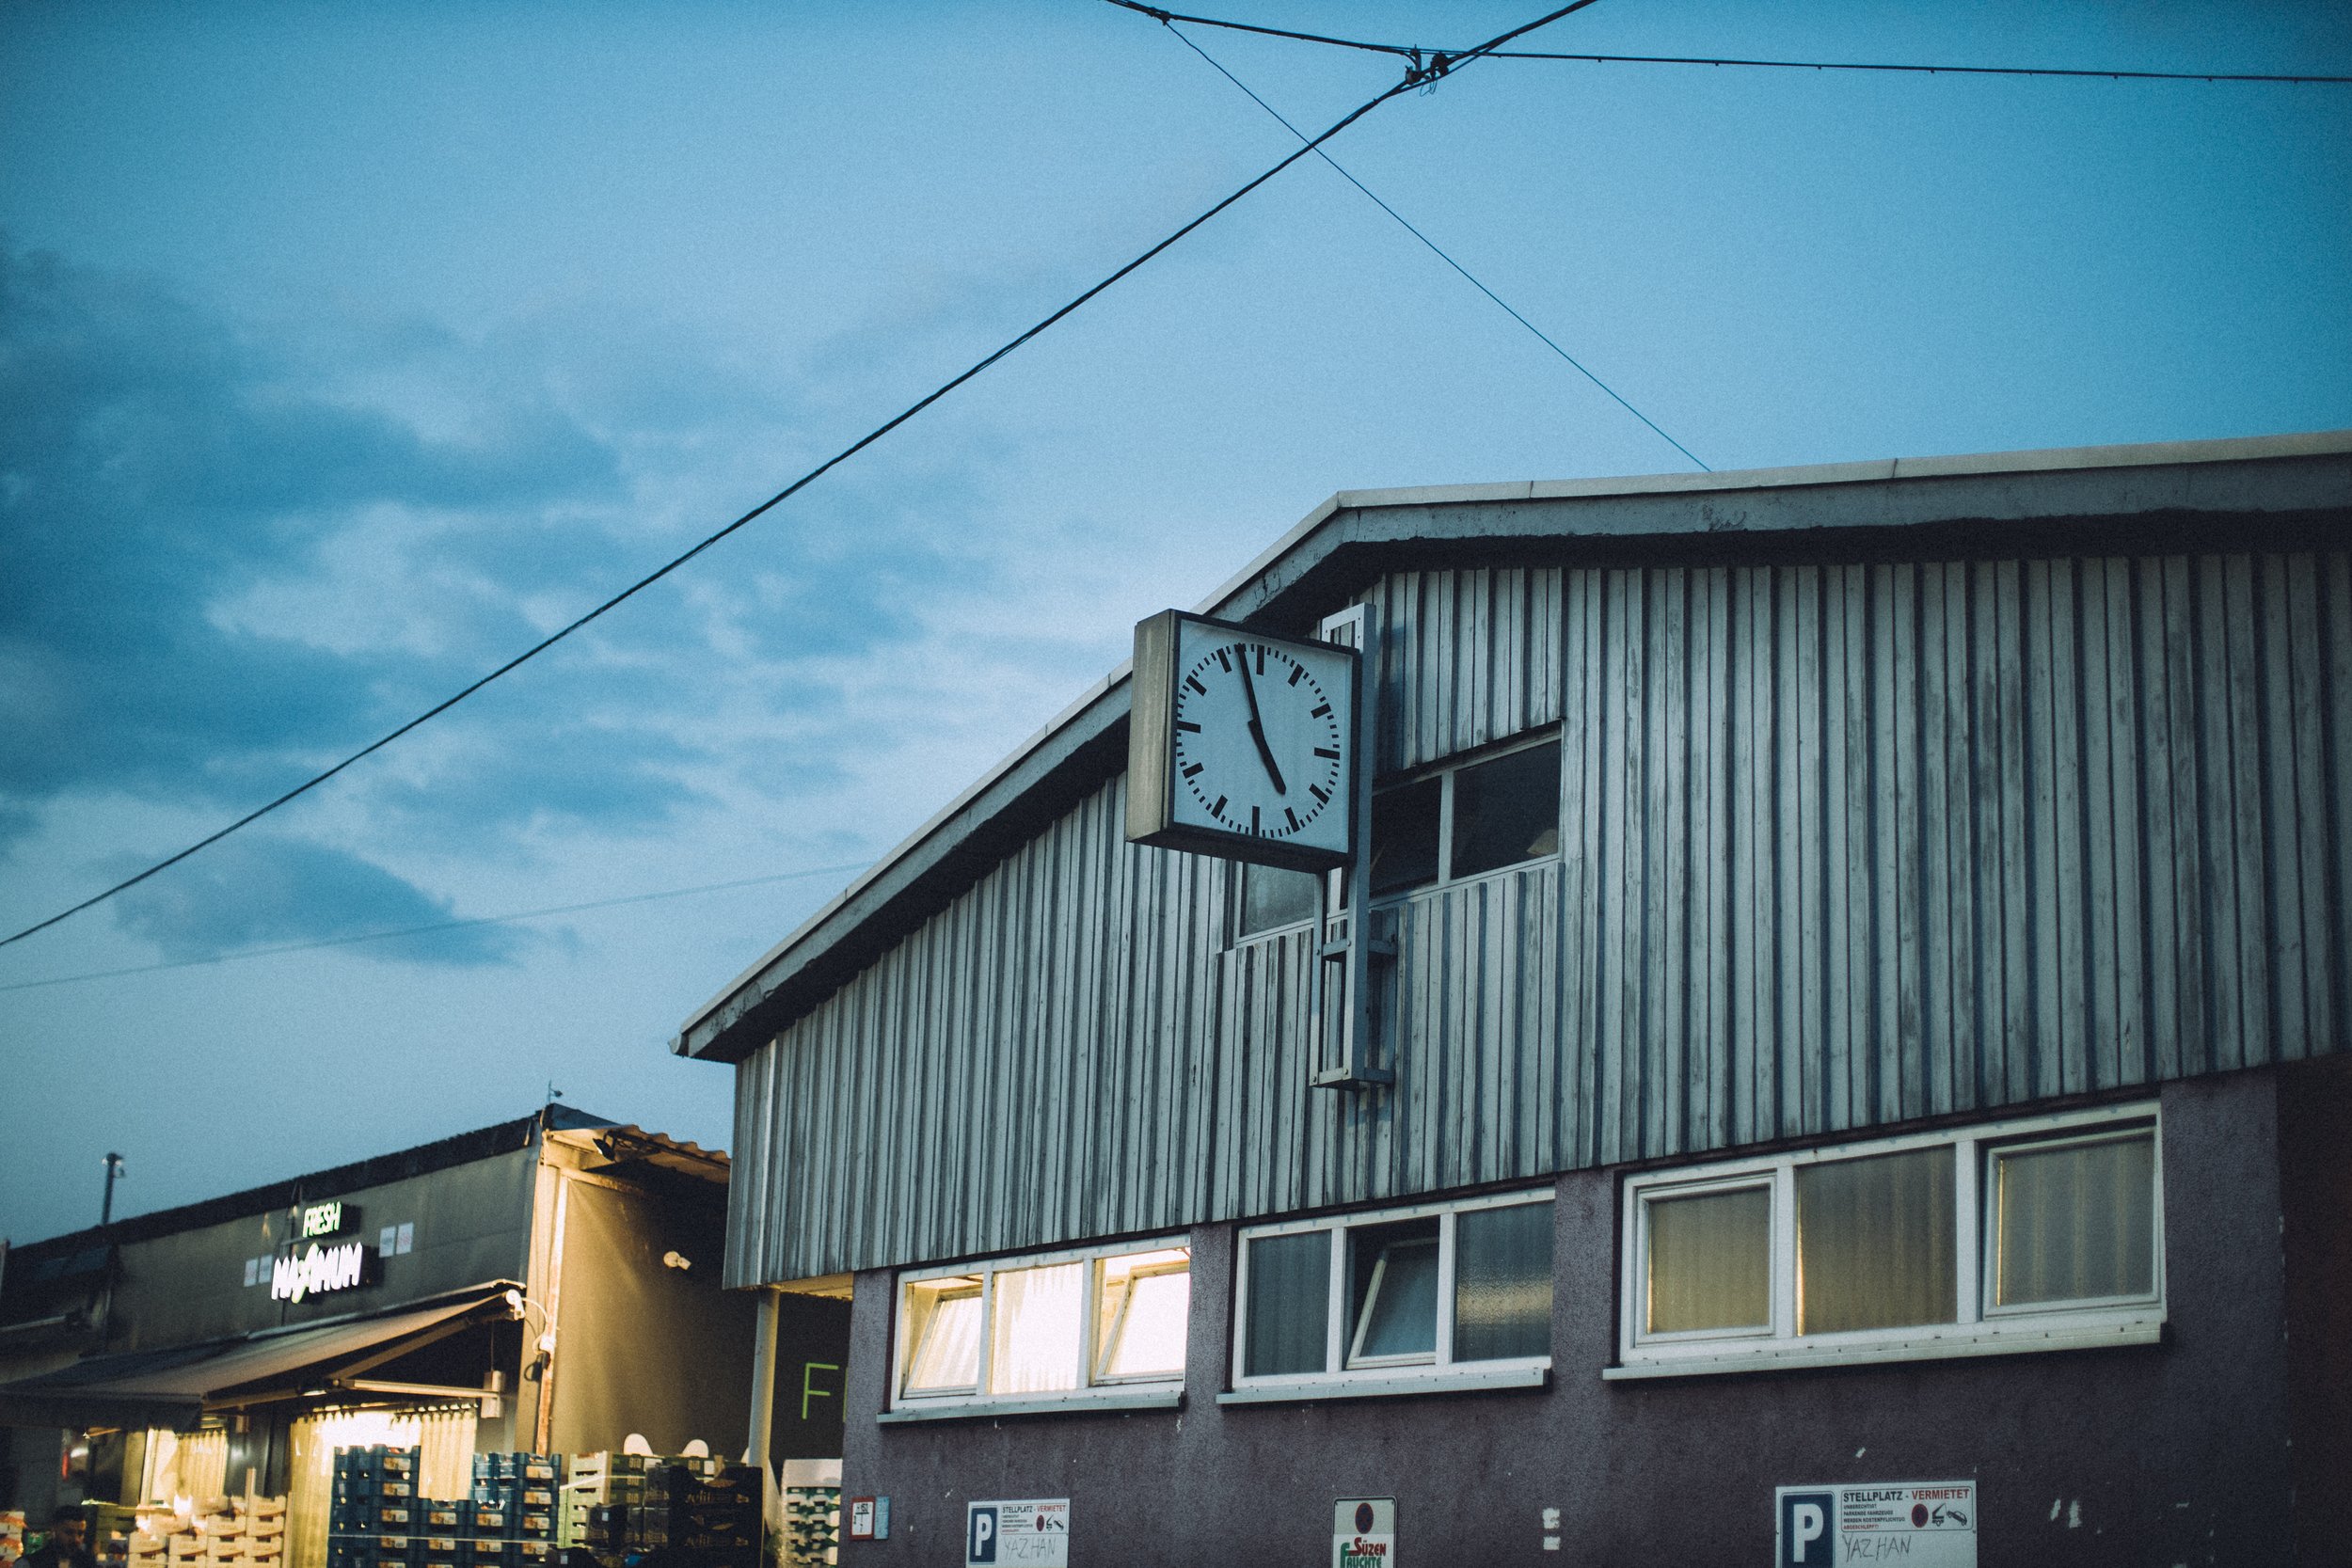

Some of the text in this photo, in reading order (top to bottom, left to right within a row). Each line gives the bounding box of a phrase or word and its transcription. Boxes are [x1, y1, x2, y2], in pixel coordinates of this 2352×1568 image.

[303, 1201, 342, 1238] FRESH
[1002, 1505, 1033, 1513] STELLPLATZ
[1037, 1504, 1066, 1513] VERMIETET
[1843, 1490, 1903, 1503] STELLPLATZ
[1912, 1488, 1970, 1500] VERMIETET
[975, 1513, 993, 1556] P
[1347, 1536, 1387, 1557] SÜZEN
[1793, 1503, 1824, 1562] P
